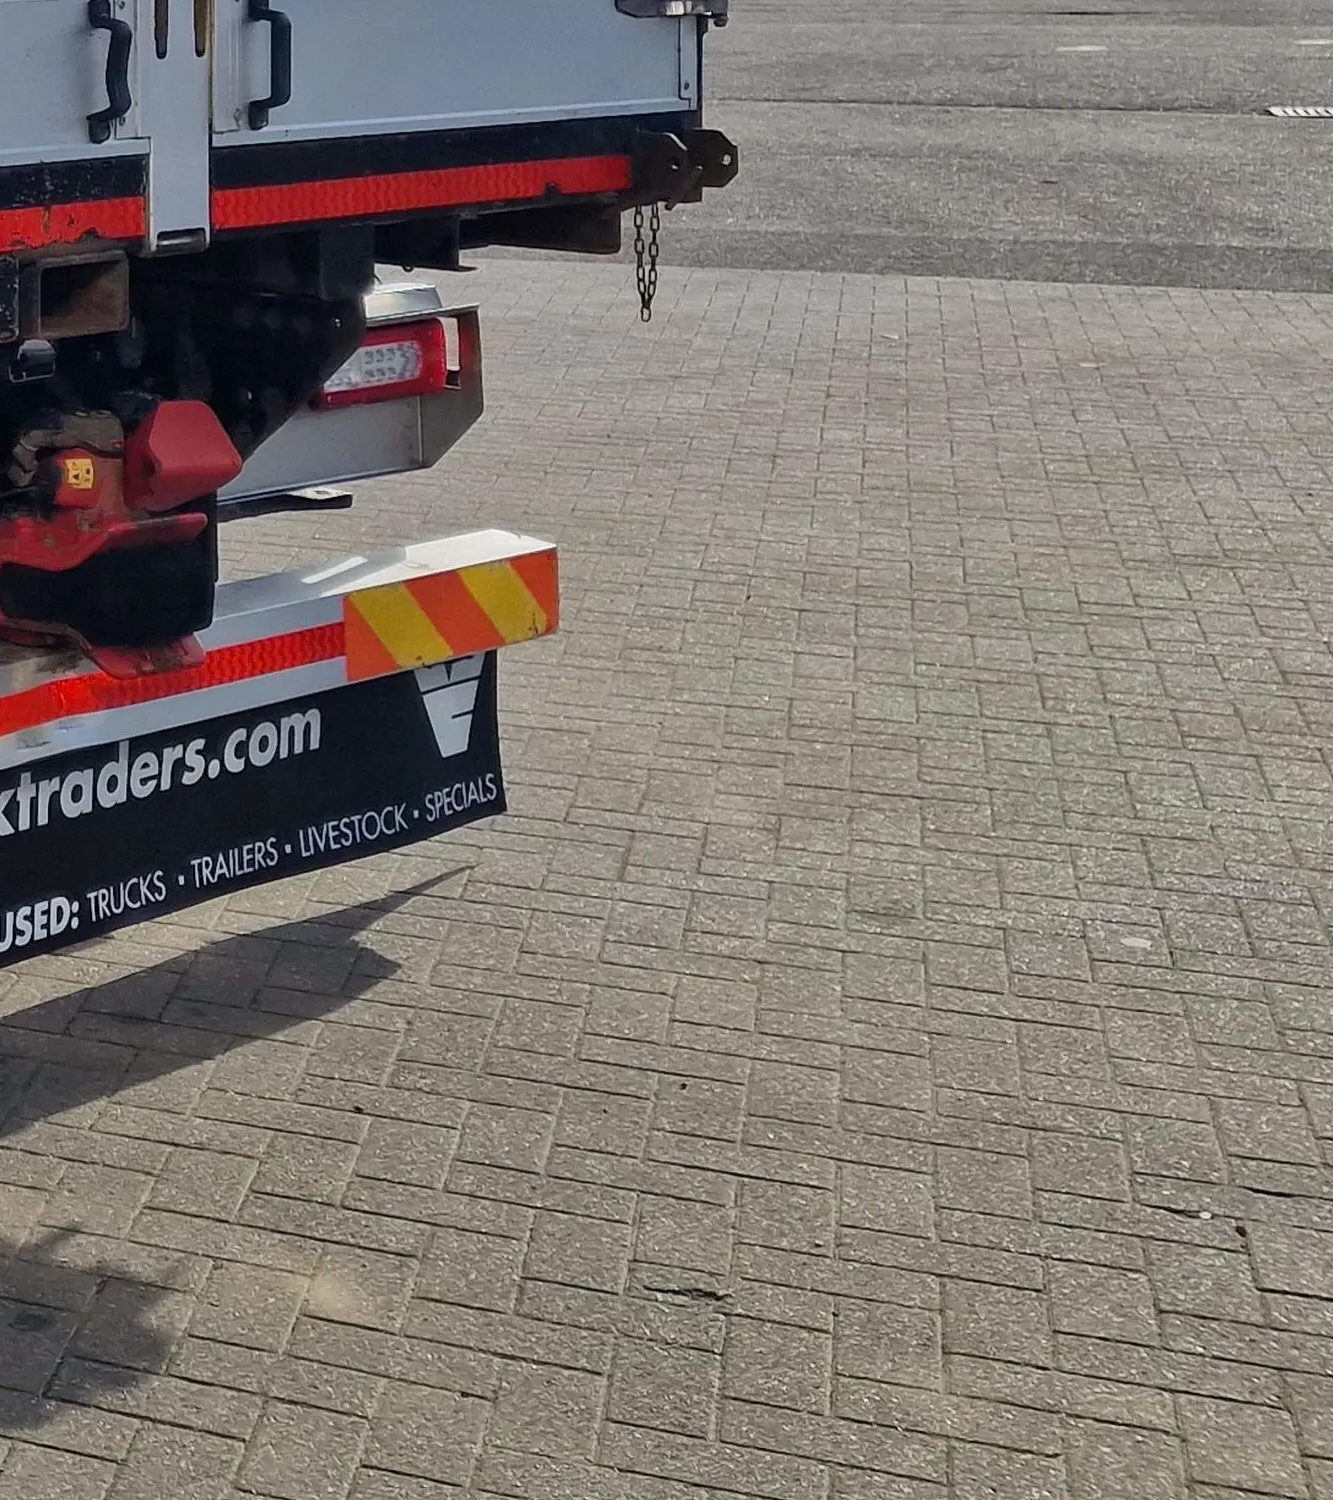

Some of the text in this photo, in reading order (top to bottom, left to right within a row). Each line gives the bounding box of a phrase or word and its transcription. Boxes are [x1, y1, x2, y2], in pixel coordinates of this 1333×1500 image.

[87, 869, 167, 922] TRUCKS
[191, 837, 279, 888] TRAILERS
[298, 802, 409, 858] LIVESTOCK
[425, 773, 498, 822] SPECIALS
